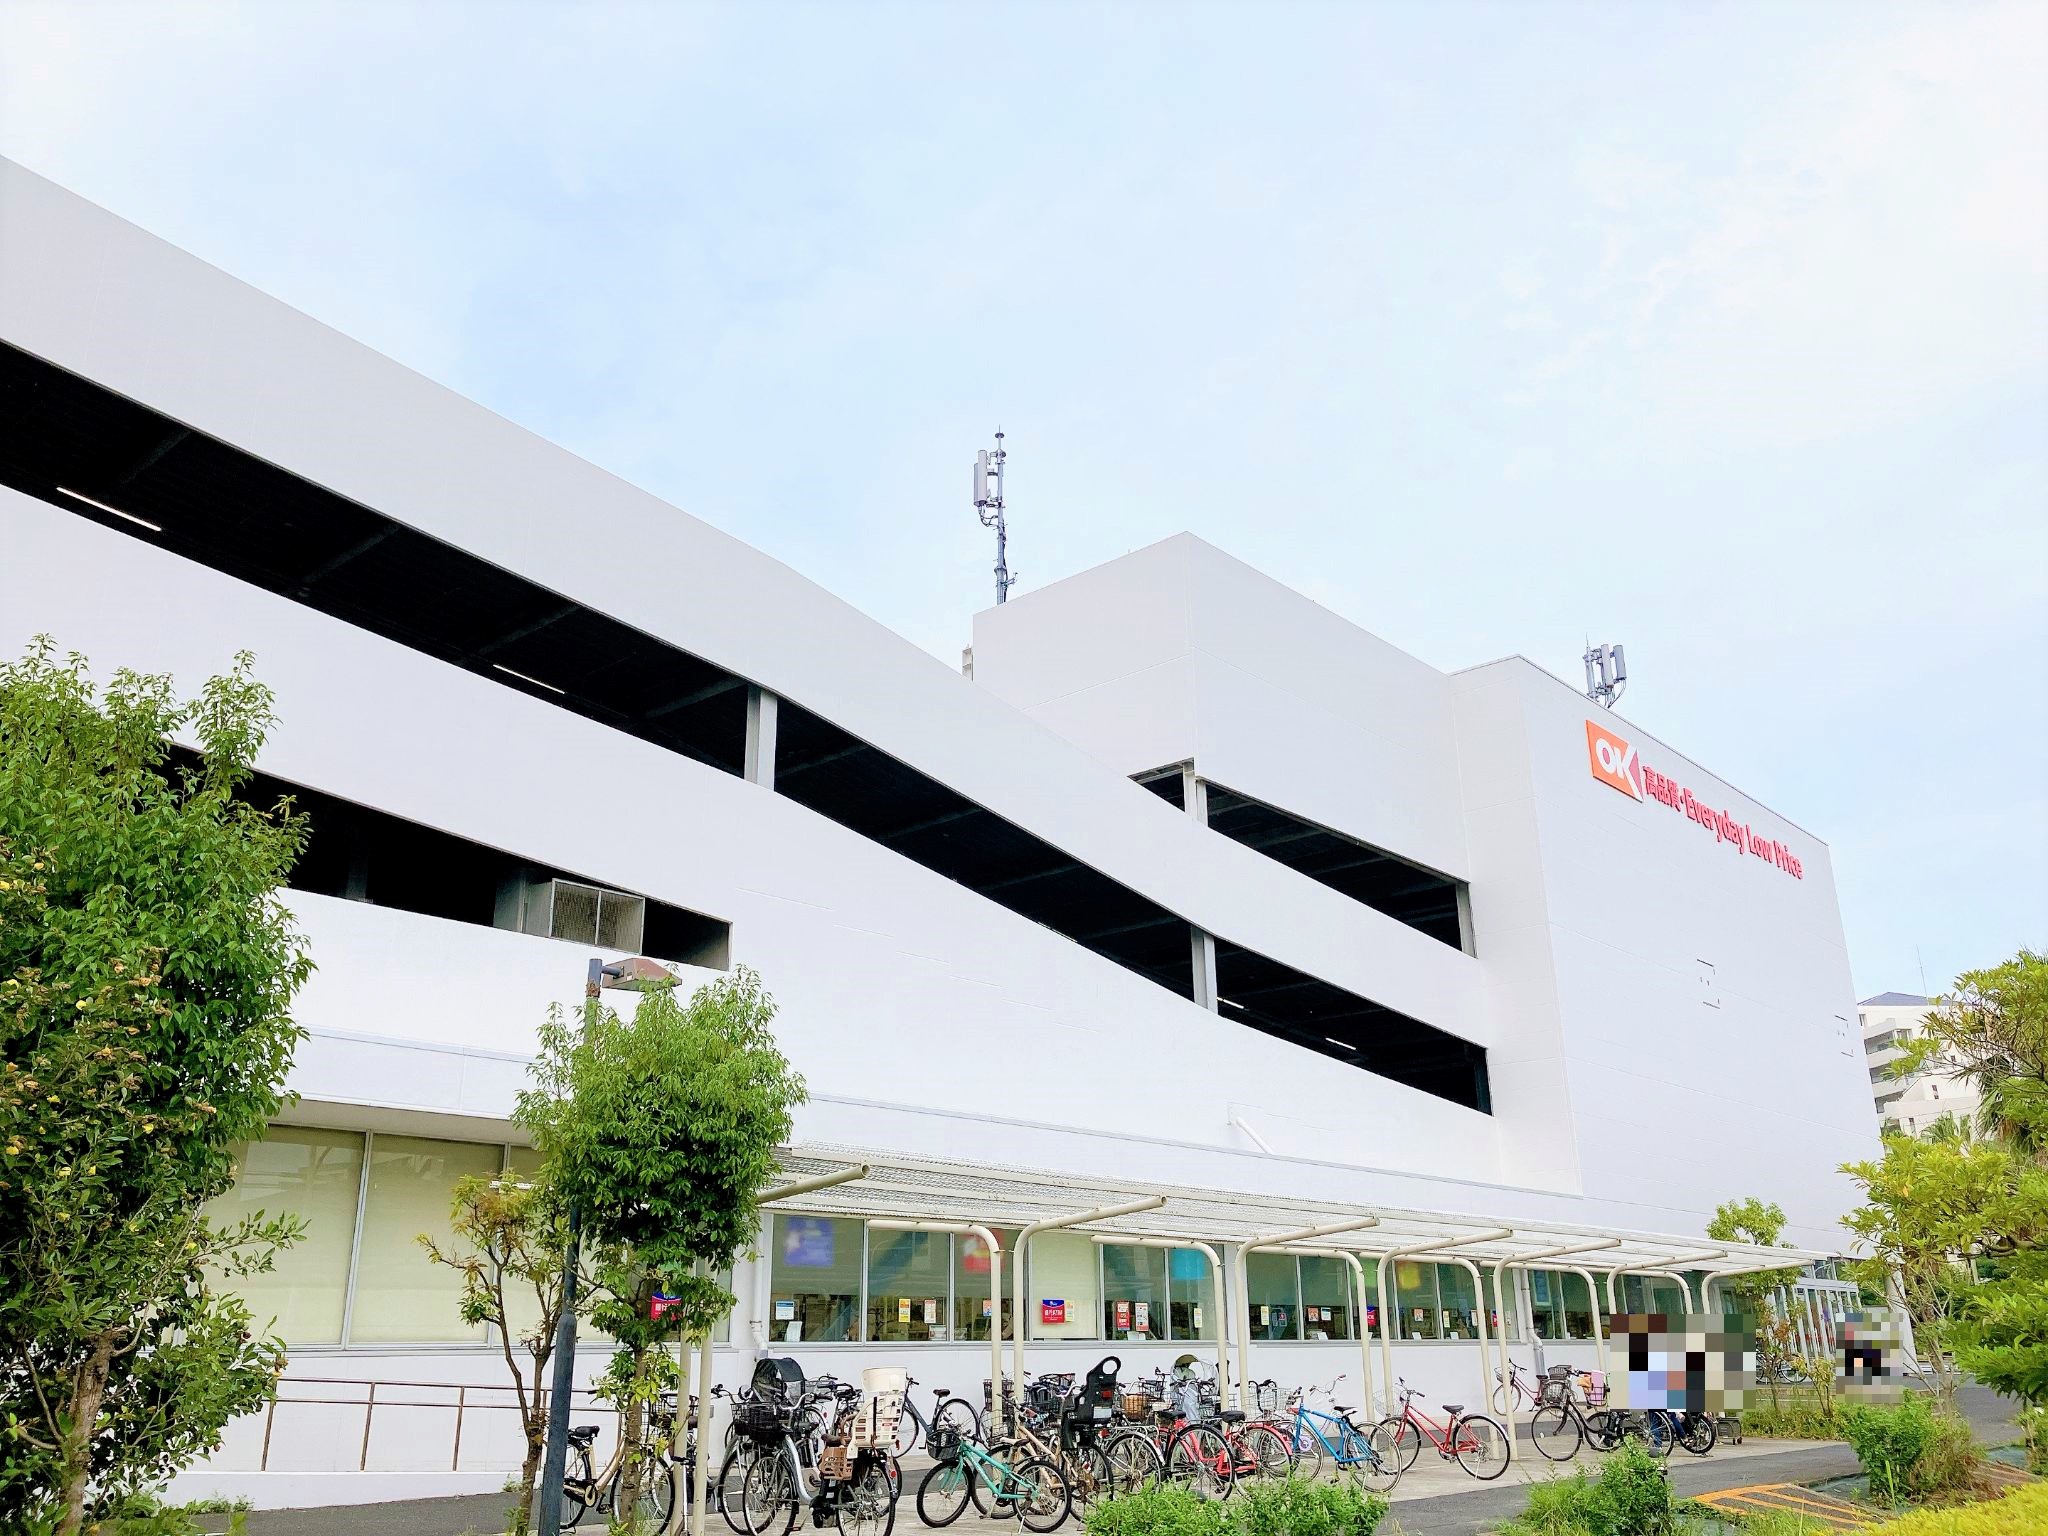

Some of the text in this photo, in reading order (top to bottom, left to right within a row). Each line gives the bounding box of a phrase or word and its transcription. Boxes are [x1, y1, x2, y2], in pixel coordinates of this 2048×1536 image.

[1595, 738, 1643, 802] OK
[1683, 787, 1744, 854] Everyday
[1746, 824, 1772, 864] Low
[1773, 839, 1802, 880] Price
